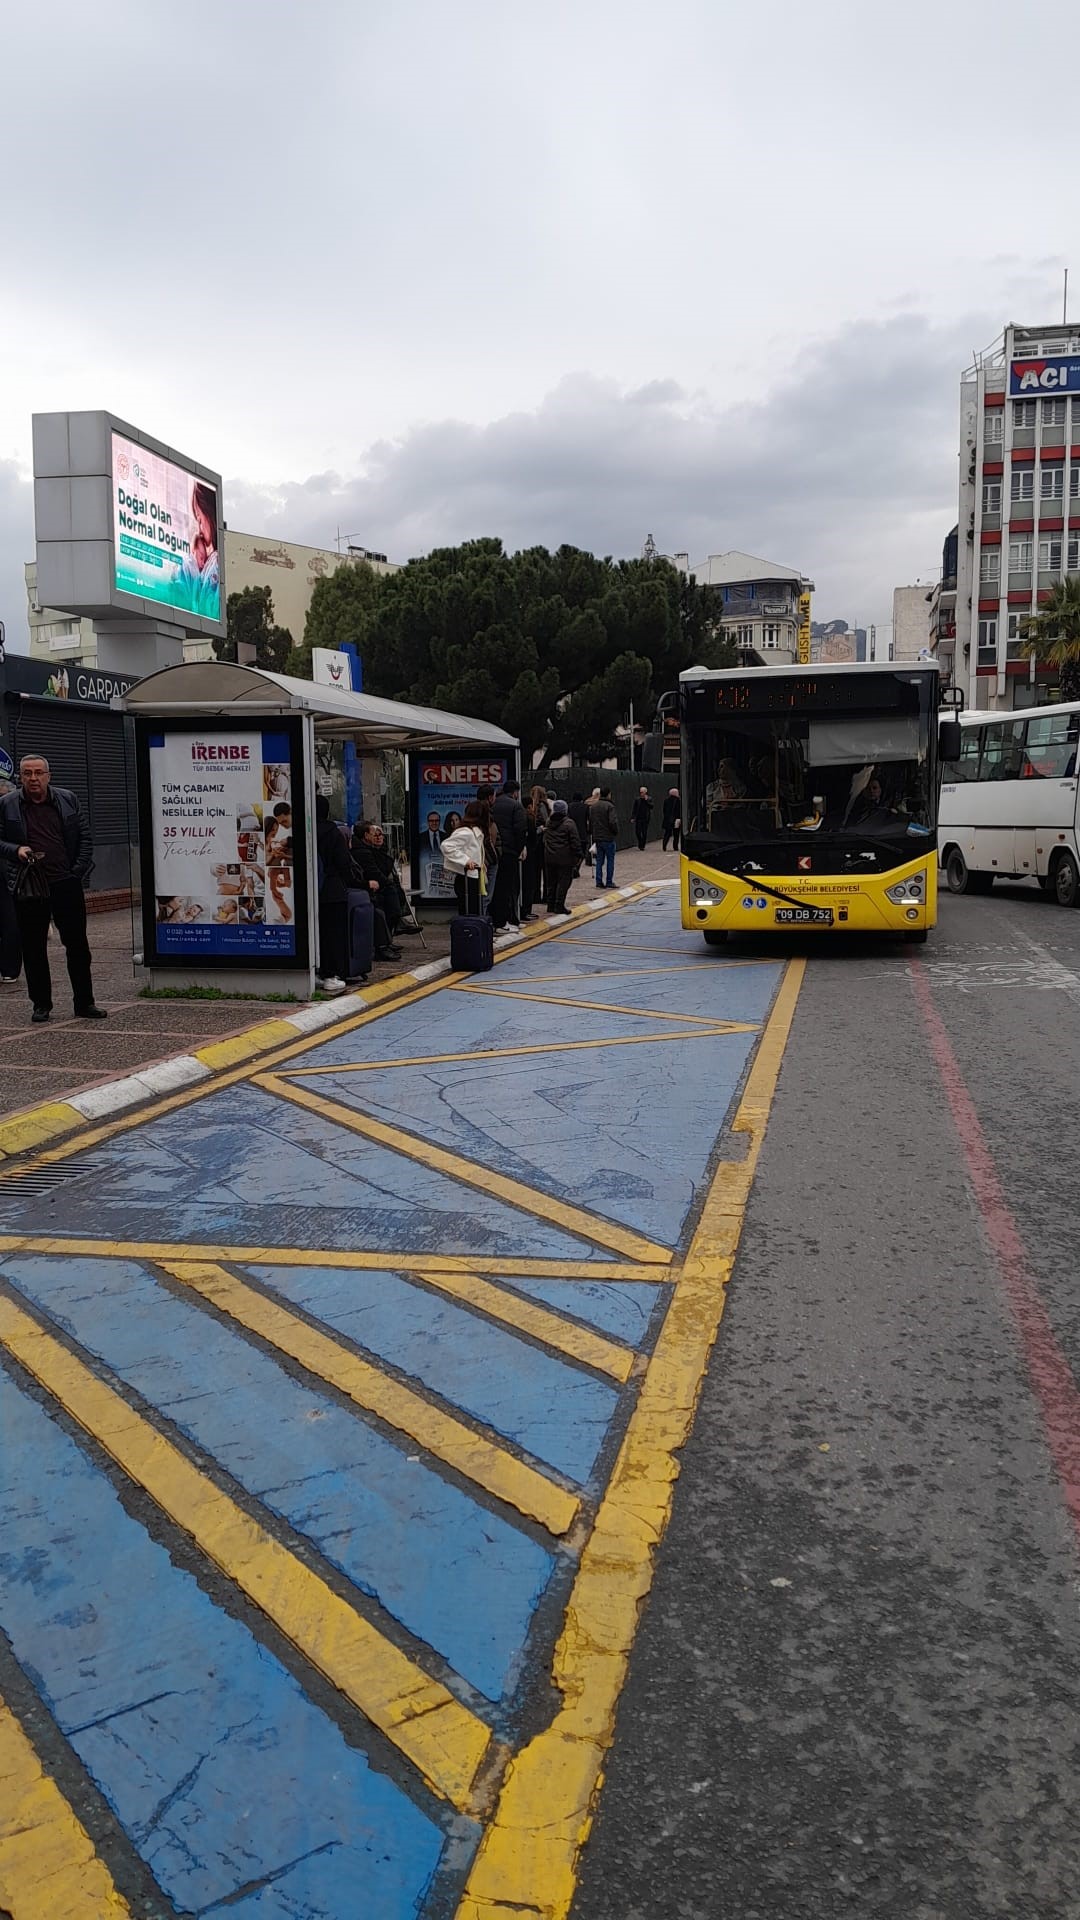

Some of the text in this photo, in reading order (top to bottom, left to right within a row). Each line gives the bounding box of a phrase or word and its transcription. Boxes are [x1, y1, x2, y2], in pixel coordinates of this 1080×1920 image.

[1020, 366, 1067, 390] AÇI
[118, 487, 172, 526] Doğal Olan
[118, 509, 156, 540] Normal
[158, 526, 191, 554] Doğum
[76, 674, 131, 701] GARPAR
[191, 743, 250, 761] İRENBE
[440, 764, 502, 783] NEFES
[161, 782, 225, 794] TÜM ÇABAMIZ
[161, 794, 202, 805] SAĞLIKLI
[162, 807, 204, 817] NESİLLER
[163, 827, 216, 837] 35 YILLIK
[774, 884, 818, 894] BÜYÜKŞEHİR
[820, 884, 860, 893] BELEDİYESİ
[780, 910, 830, 919] 09 DB 752
